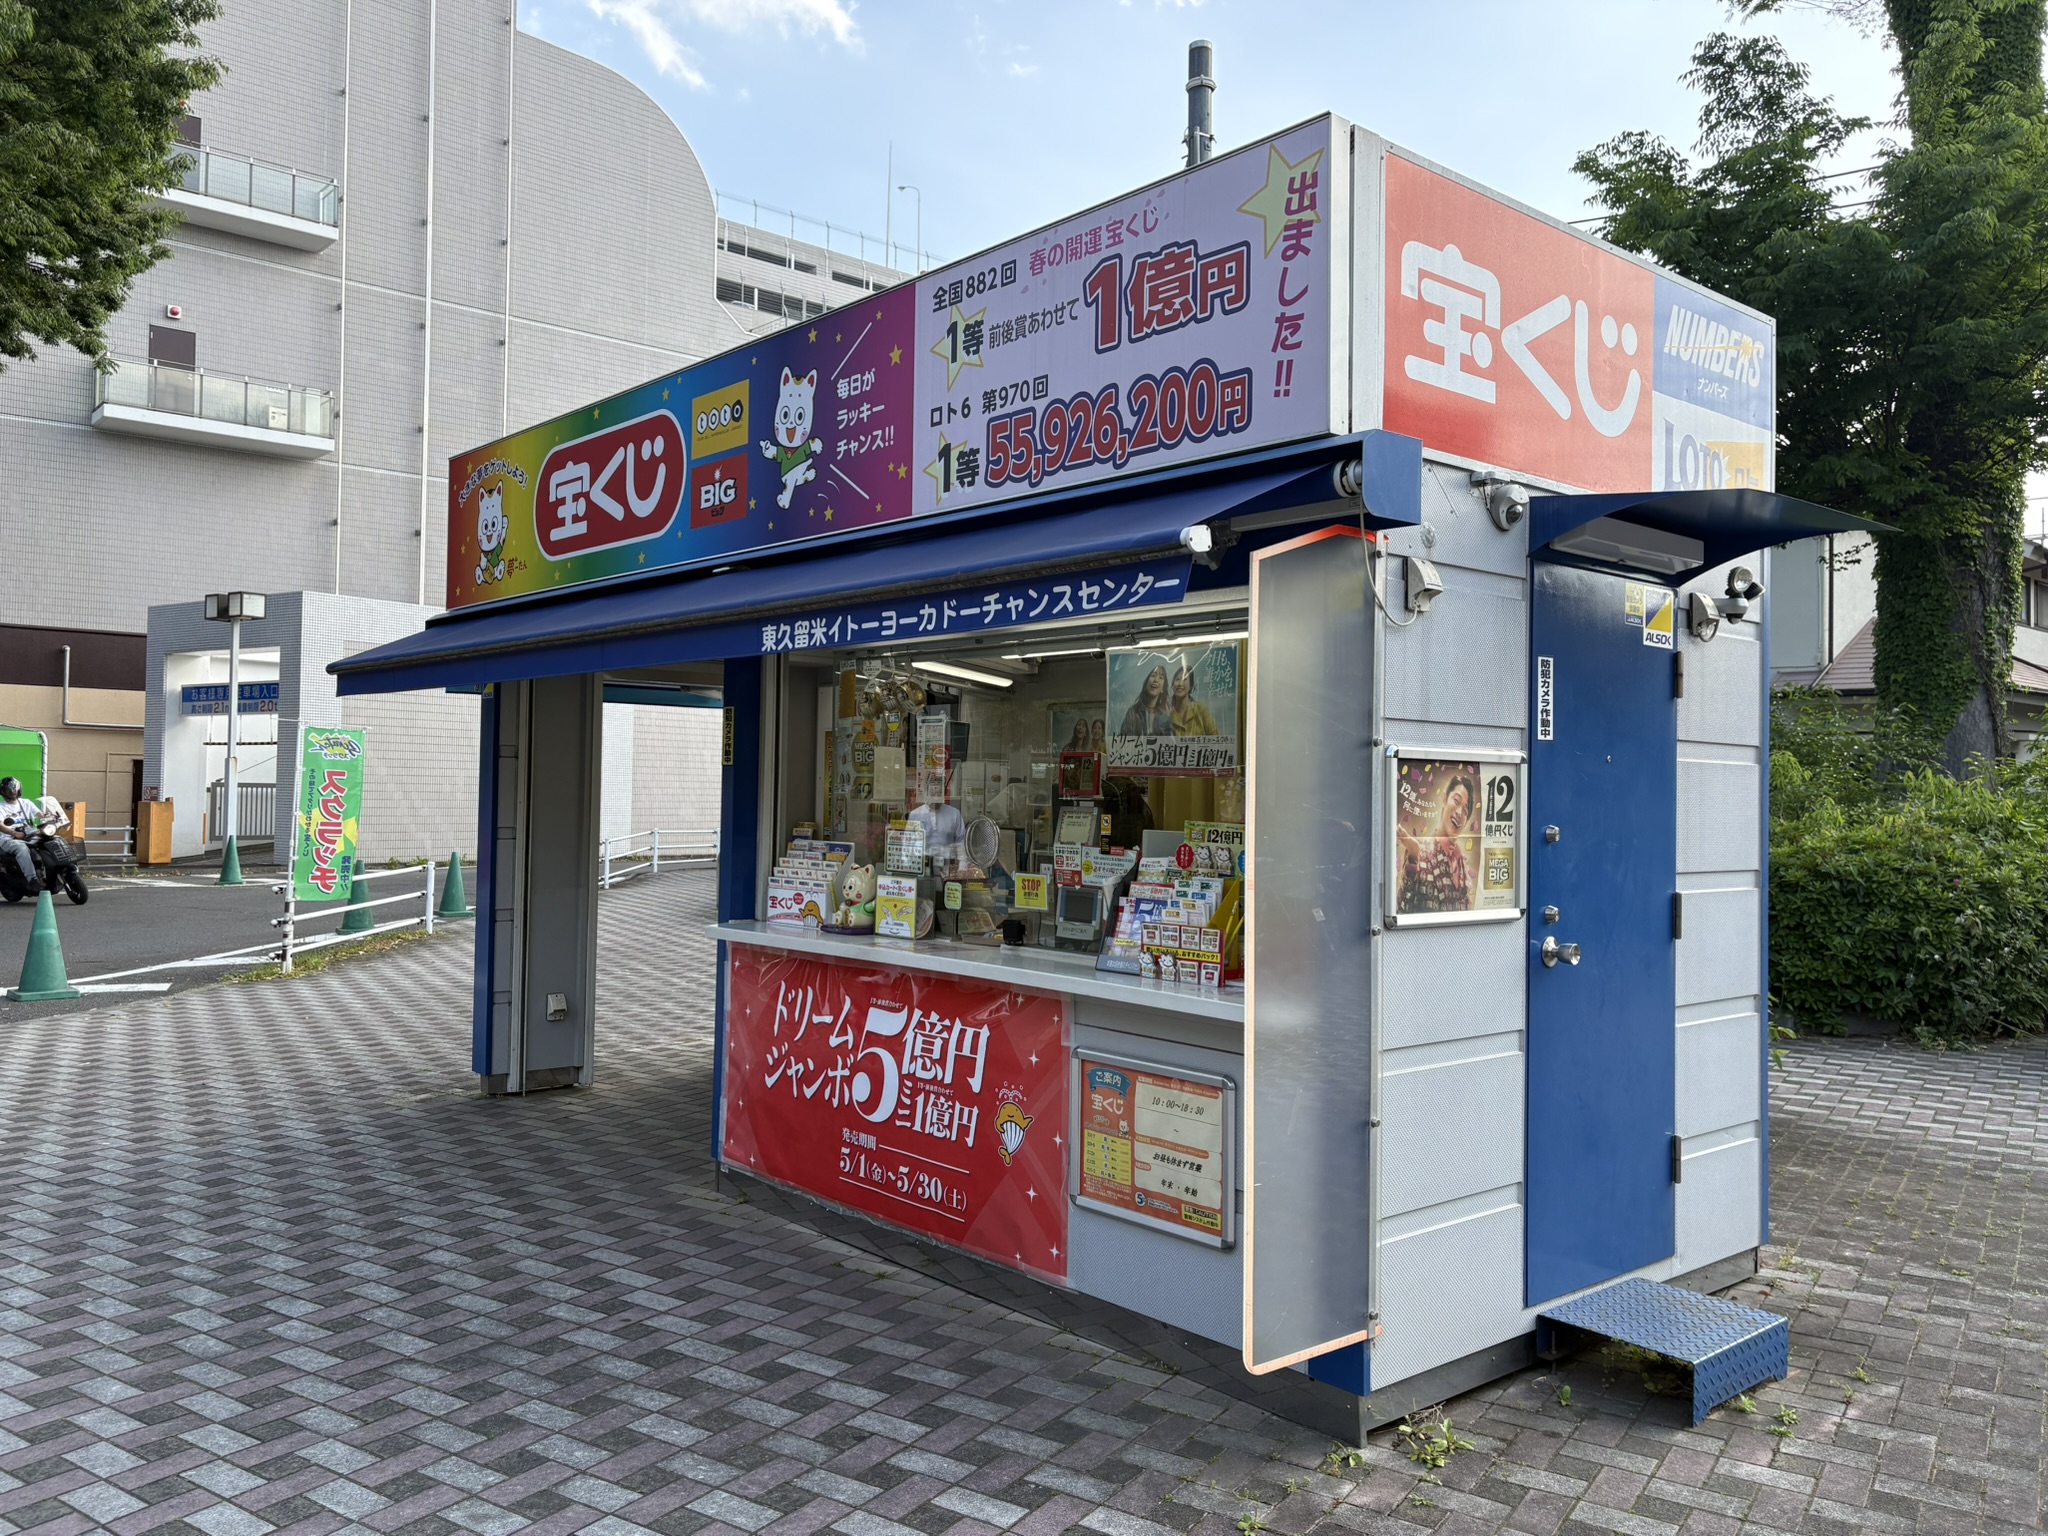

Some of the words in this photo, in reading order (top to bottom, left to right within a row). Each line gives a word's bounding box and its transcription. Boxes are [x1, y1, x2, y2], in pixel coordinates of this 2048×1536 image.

[1029, 207, 1159, 277] 春の開運宝くじ
[932, 259, 1017, 314] 全国882回
[1084, 240, 1250, 353] 1億円
[1271, 170, 1320, 398] 出ました!!
[946, 319, 985, 364] 1等
[988, 297, 1079, 350] 前後賞あわせて
[1401, 240, 1641, 437] 宝くじ
[1664, 304, 1764, 388] NUMBERS
[836, 368, 876, 400] 毎日が
[982, 375, 1049, 416] 第970回
[1697, 377, 1728, 399] ナンバーズ
[697, 399, 744, 435] toto
[836, 402, 886, 429] ラッキー
[984, 359, 1252, 487] 55,926,200円
[836, 426, 894, 460] チャンス!!
[1664, 417, 1723, 490] LOTO
[457, 457, 529, 509] 大きな夢をゲットしよう!
[938, 442, 980, 493] 1等
[549, 435, 666, 542] 宝くじ
[700, 478, 737, 511] BIG
[760, 572, 1181, 653] 東久留米イトーヨーカドーチャンスセンター
[1645, 632, 1672, 646] ALSOK
[1540, 659, 1551, 739] 防犯カメラ作動中
[854, 751, 875, 763] BIG
[1109, 749, 1144, 766] ジャンボ
[1111, 732, 1143, 749] ドリーム
[1144, 737, 1189, 767] 5億円
[1195, 747, 1229, 768] 1億円
[1486, 775, 1514, 822] 12
[1207, 829, 1243, 845] 12億円
[1485, 824, 1514, 837] 億円くじ
[1021, 878, 1041, 891] STOP
[1488, 868, 1509, 881] BIG
[769, 895, 793, 911] 宝くじ
[773, 980, 854, 1050] ドリーム
[764, 1041, 856, 1109] ジャンボ
[852, 1005, 991, 1124] 5億円
[1095, 1071, 1122, 1088] ご案内
[911, 1091, 980, 1148] 1億円
[1091, 1093, 1124, 1115] 宝くじ
[841, 1127, 877, 1151] 発売期間
[1152, 1151, 1203, 1174] お昼も休まず営業
